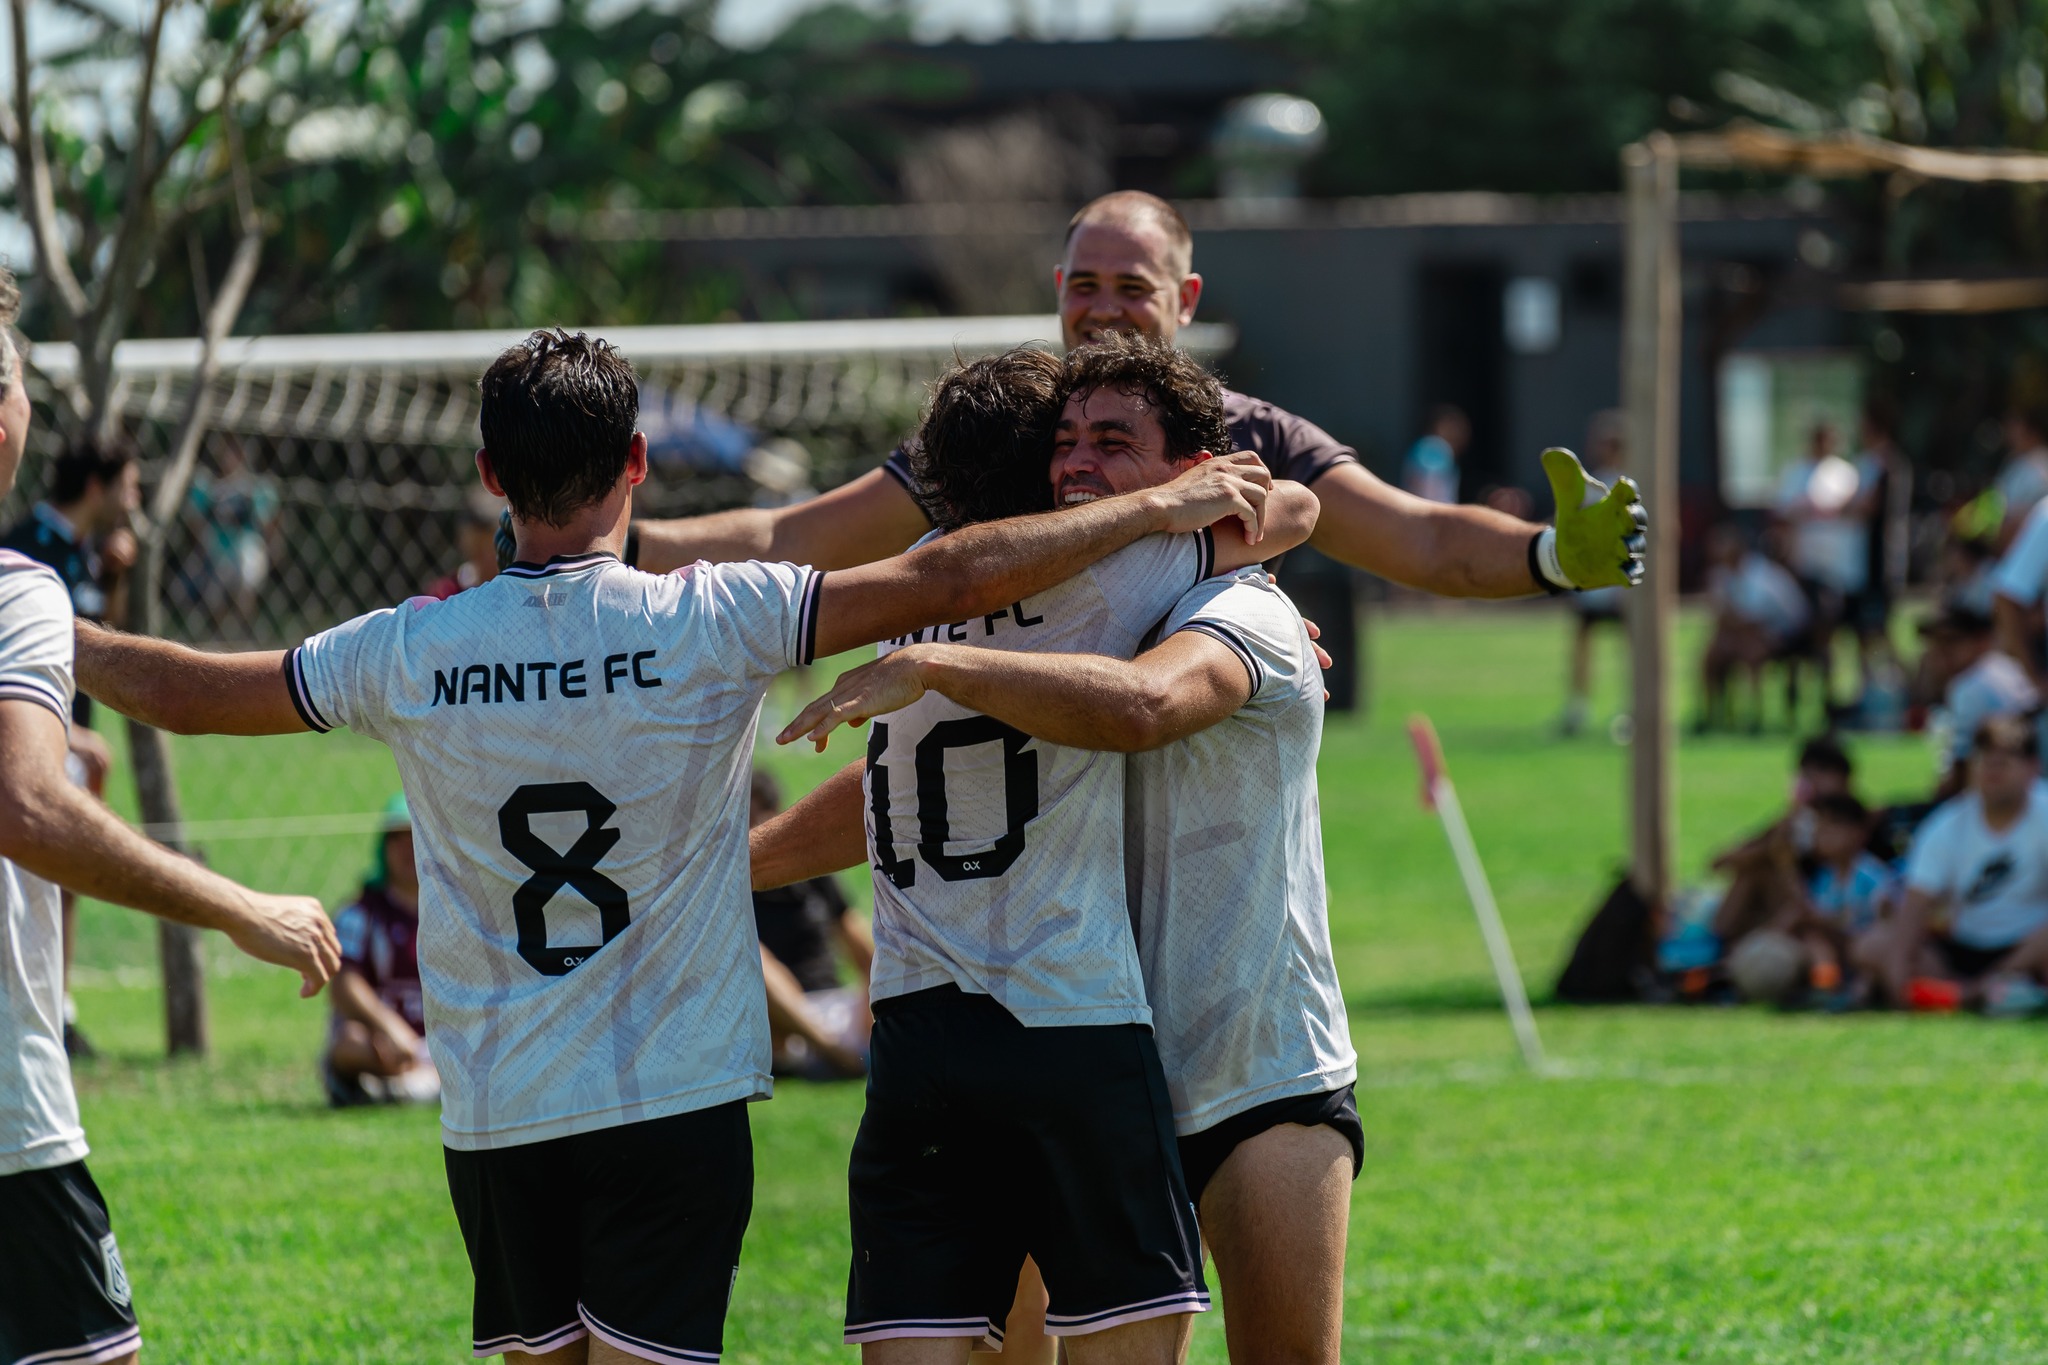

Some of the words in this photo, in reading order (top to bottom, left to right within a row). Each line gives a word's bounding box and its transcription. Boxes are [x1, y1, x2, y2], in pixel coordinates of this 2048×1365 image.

[431, 659, 587, 707] NANTE
[604, 649, 662, 694] FC
[498, 781, 631, 976] 8
[867, 714, 1039, 889] 10
